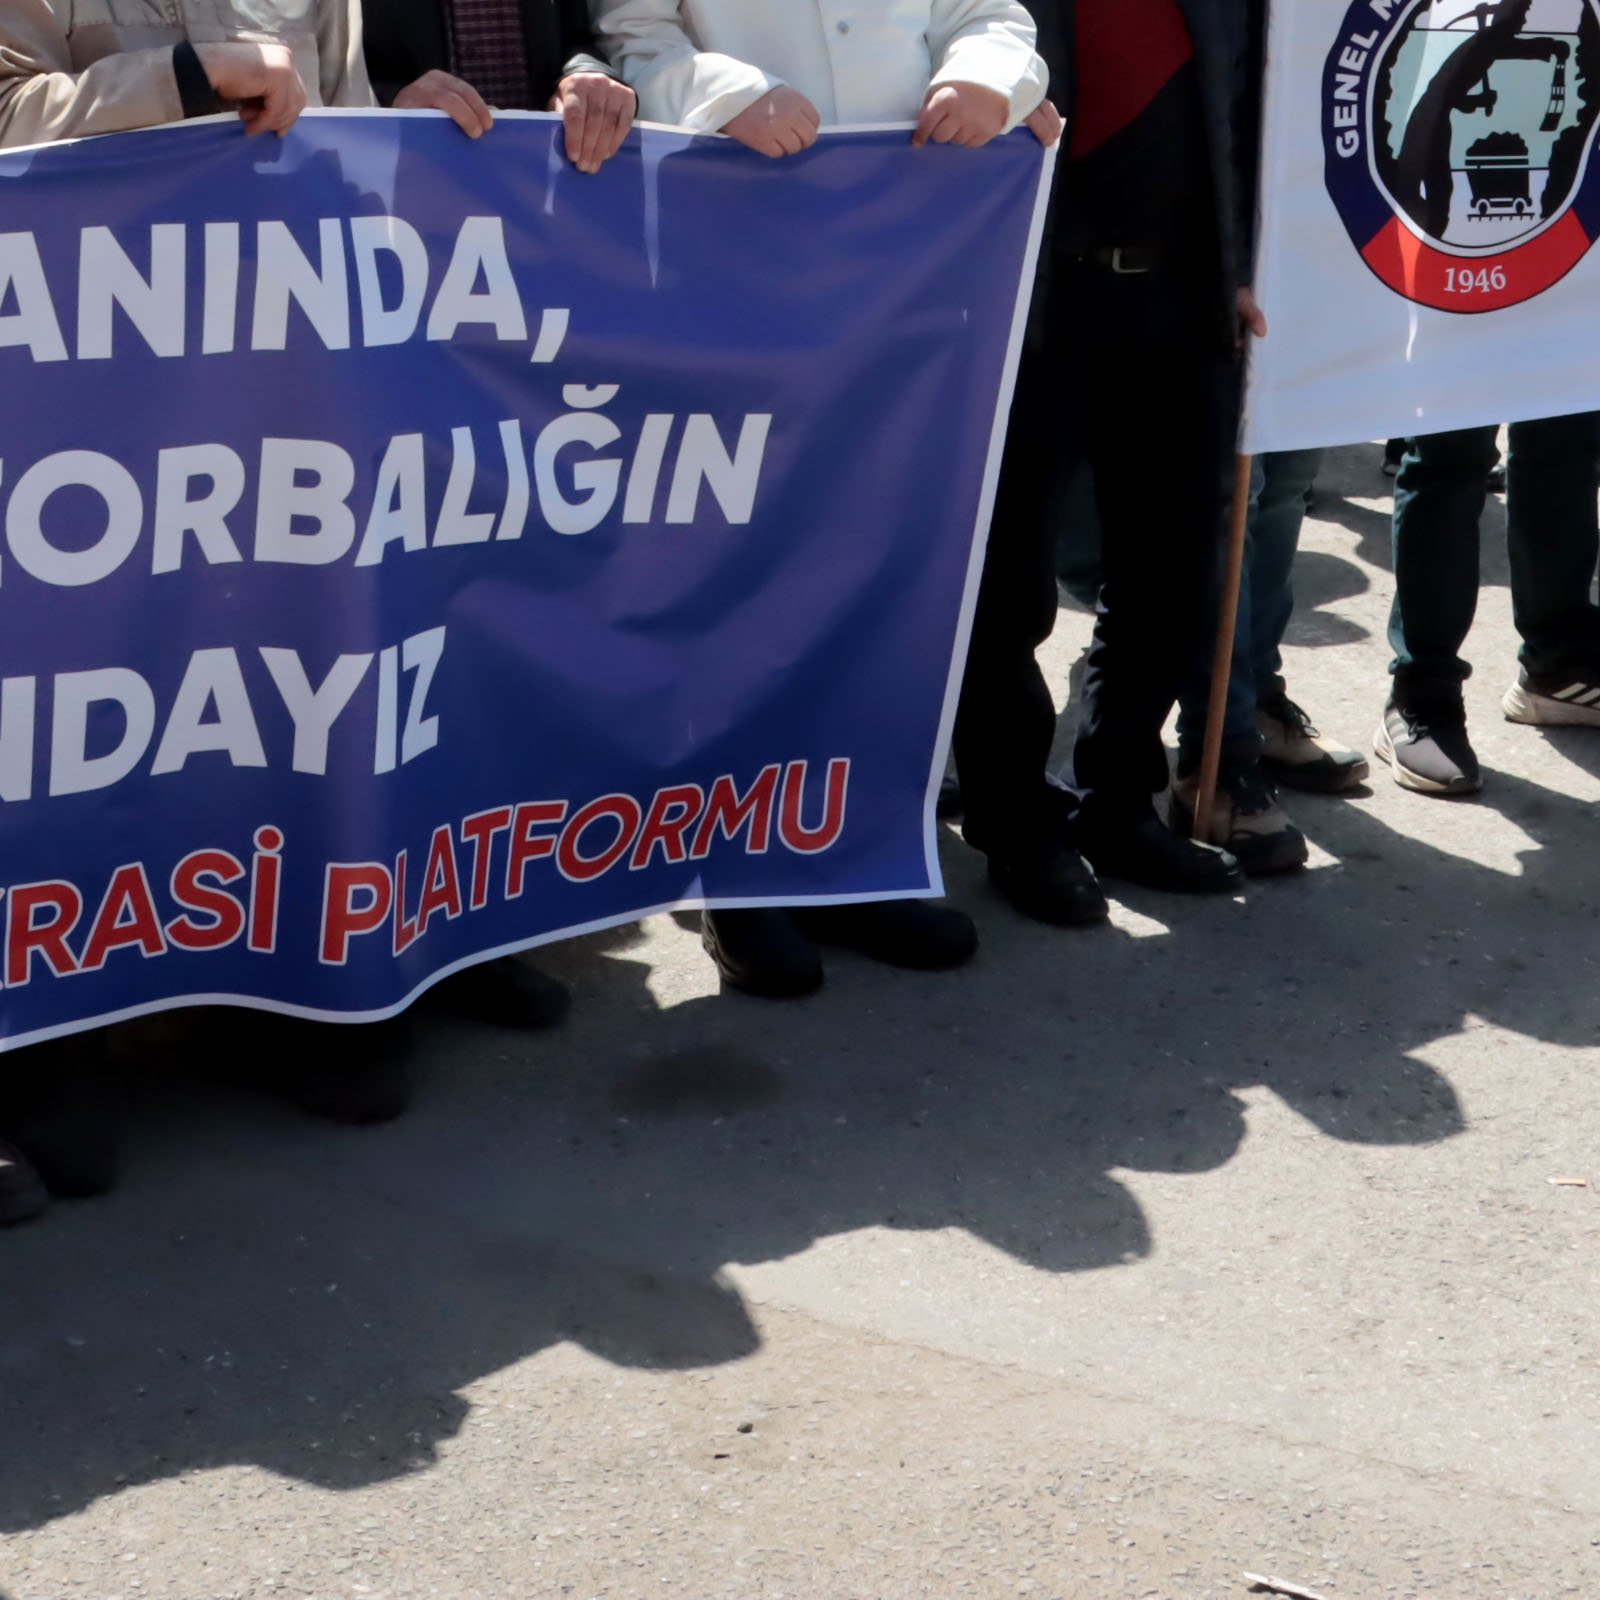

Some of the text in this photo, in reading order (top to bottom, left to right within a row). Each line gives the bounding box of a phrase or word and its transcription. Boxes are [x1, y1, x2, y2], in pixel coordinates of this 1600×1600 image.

[1333, 28, 1380, 158] GENEL
[1443, 264, 1507, 293] 1946
[317, 756, 852, 967] PLATFORMU
